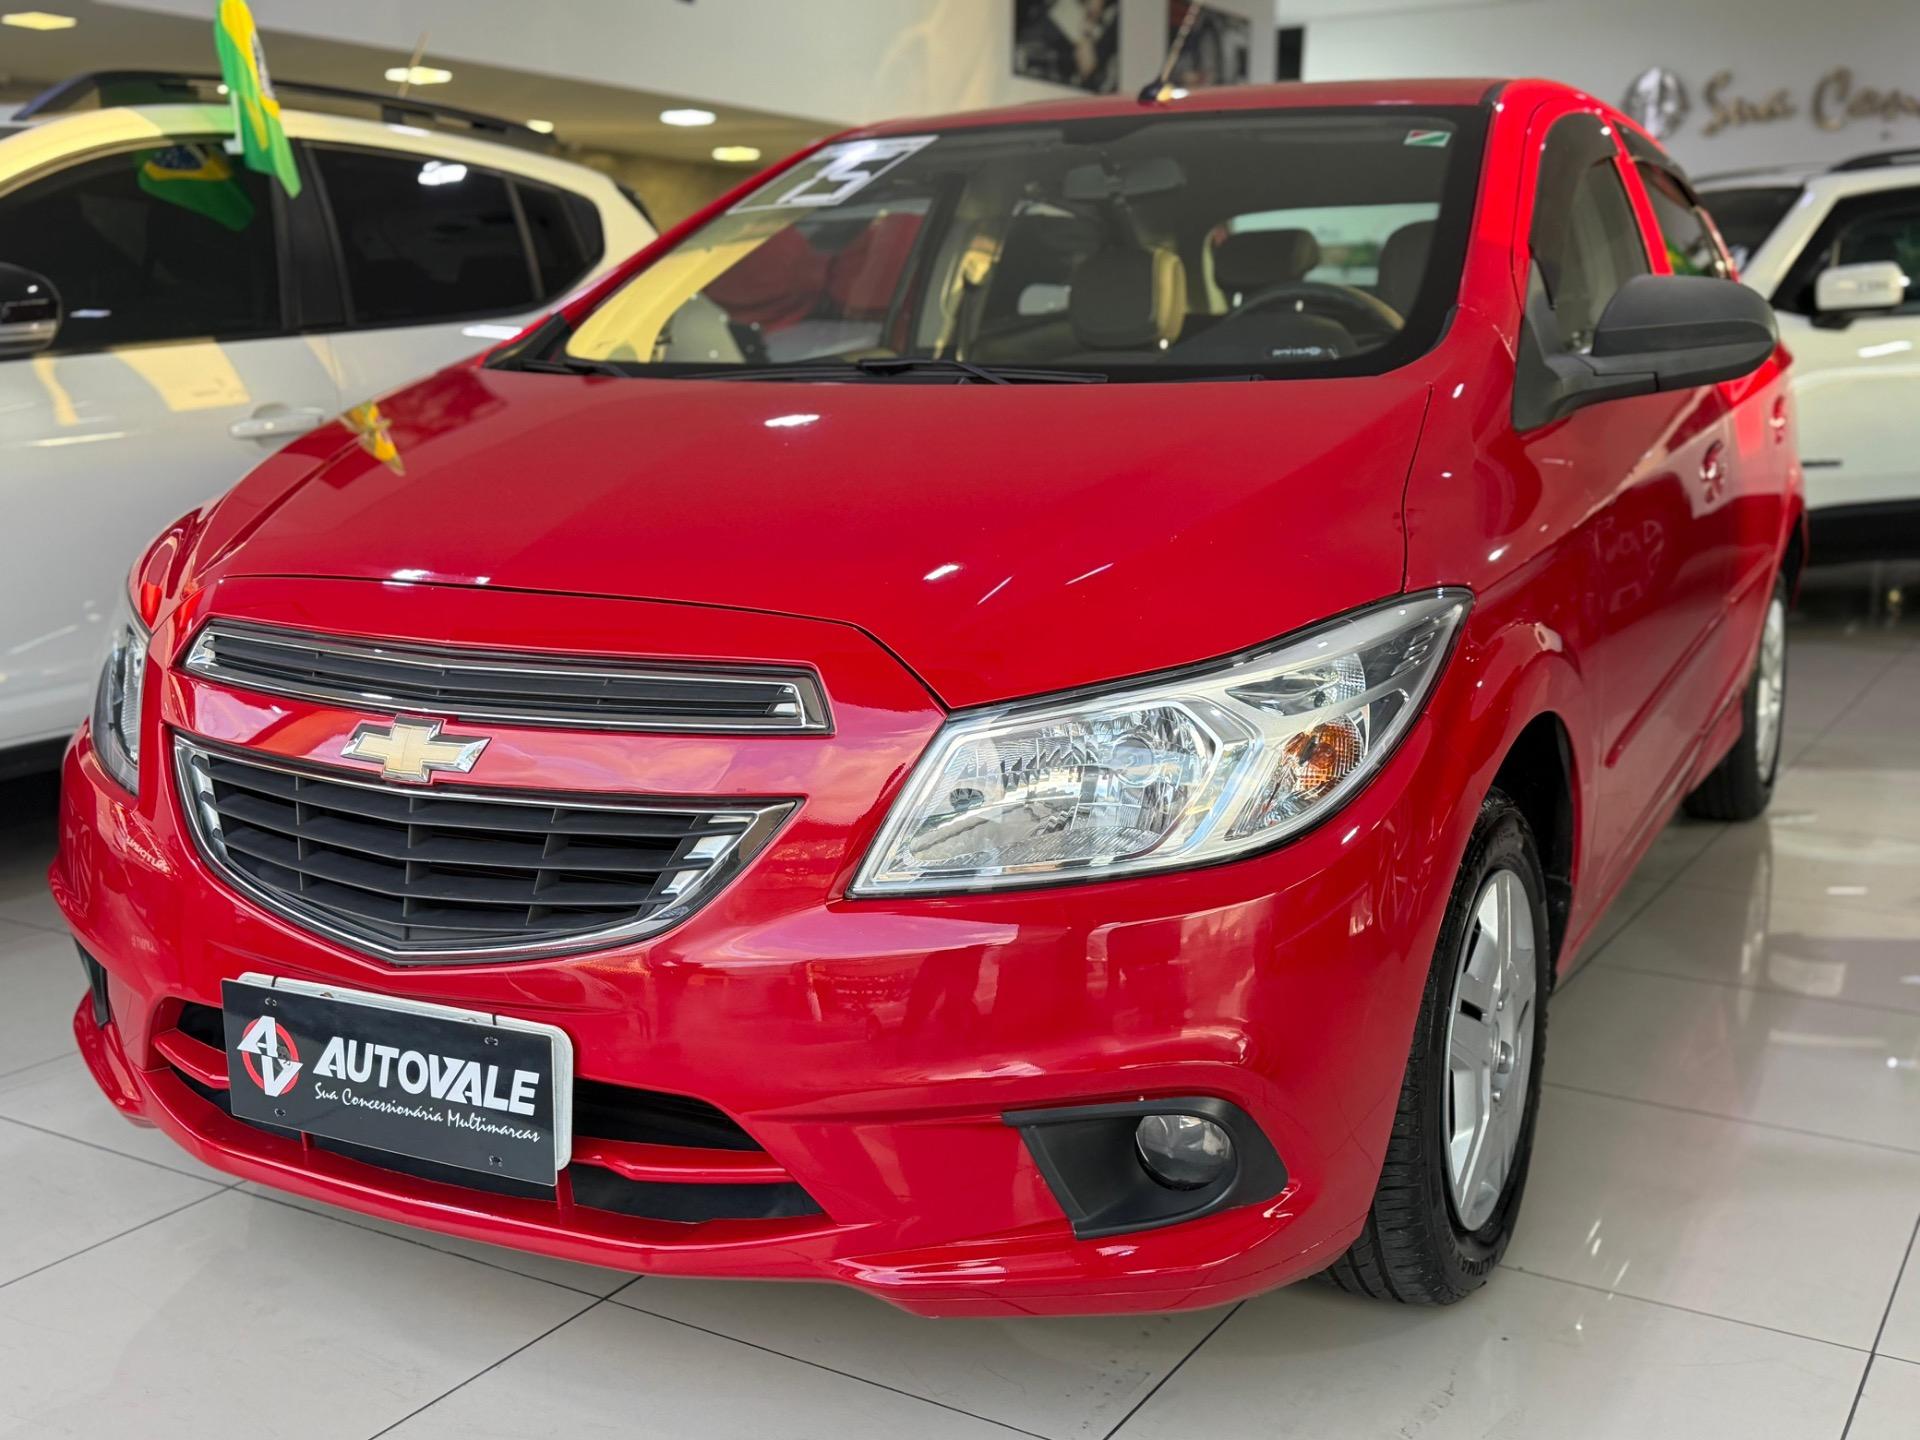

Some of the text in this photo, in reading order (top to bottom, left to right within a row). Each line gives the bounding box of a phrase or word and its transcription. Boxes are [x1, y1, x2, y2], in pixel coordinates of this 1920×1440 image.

[312, 1036, 540, 1117] AUTOVALE
[313, 1081, 541, 1143] Sua Concessionária Multimarcas
